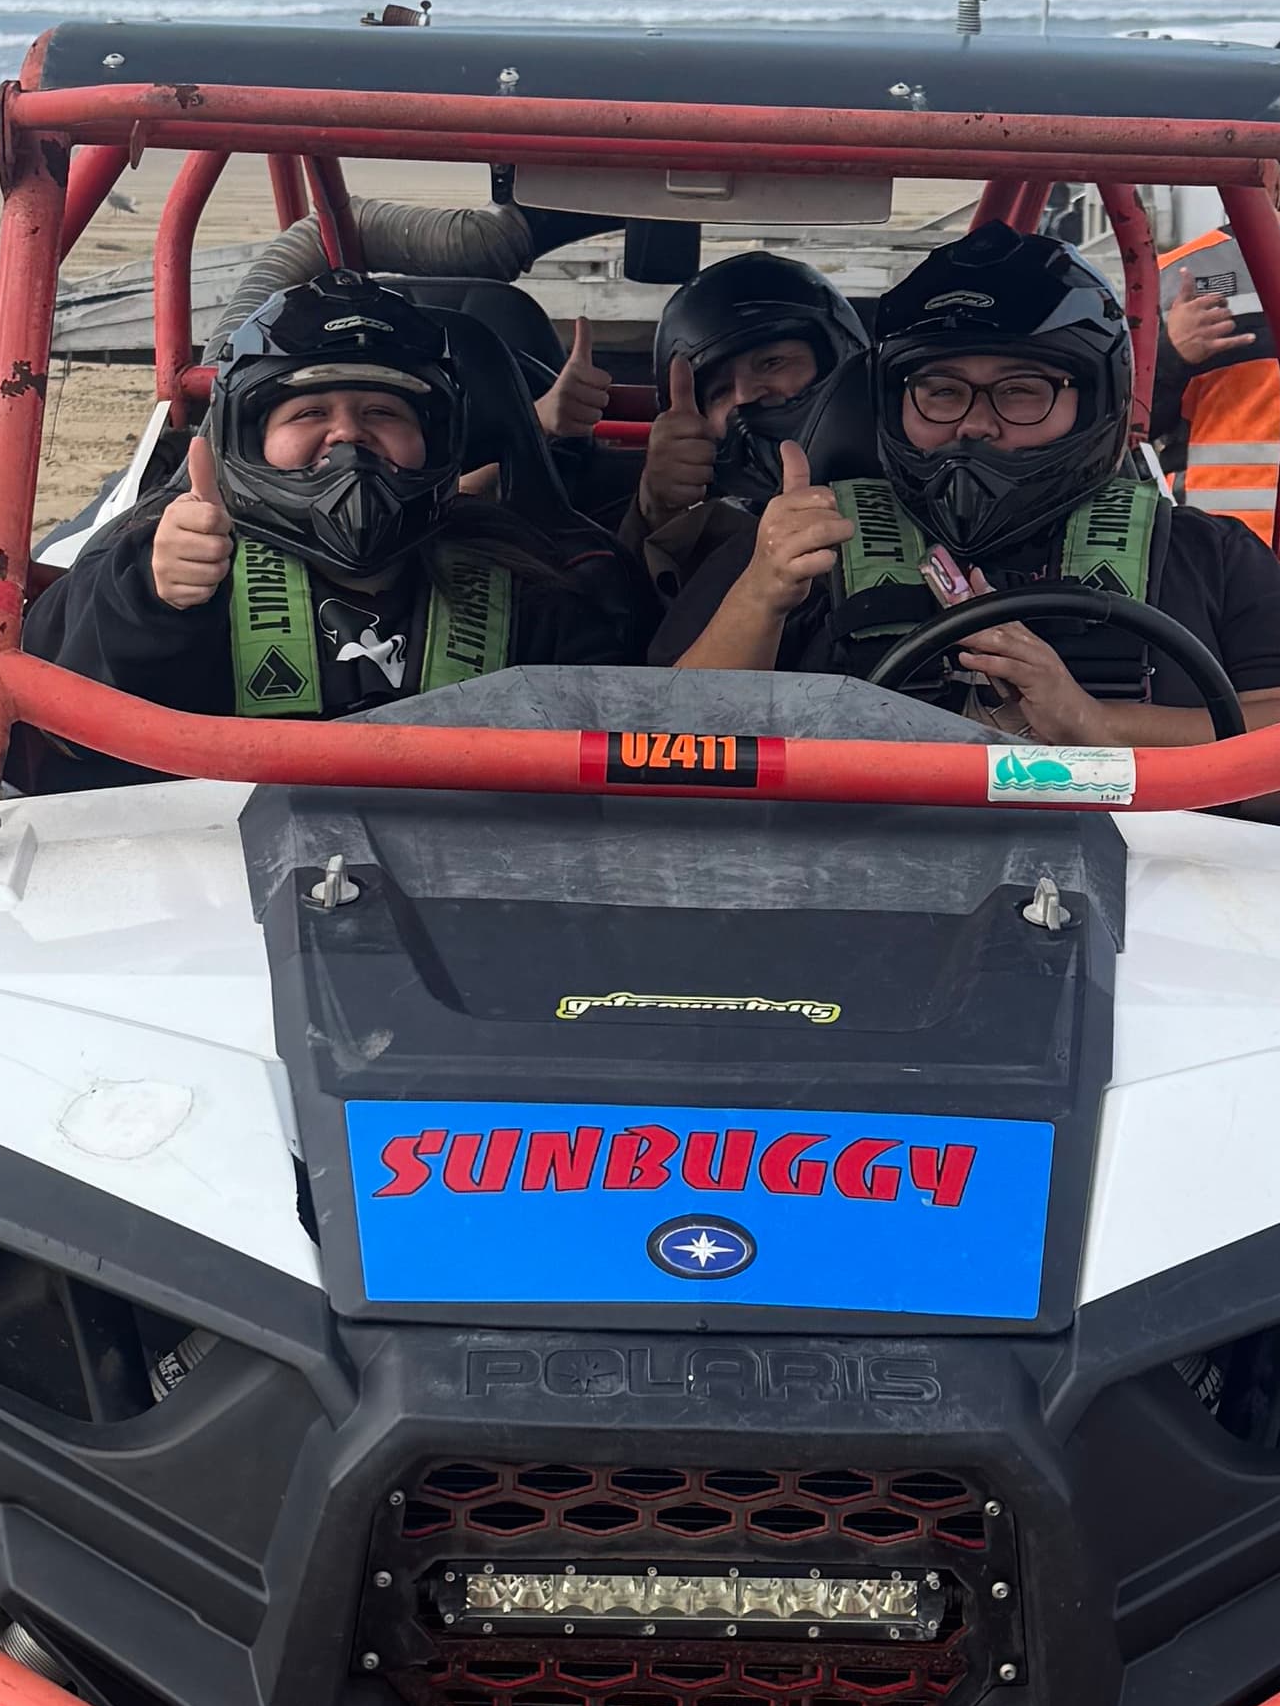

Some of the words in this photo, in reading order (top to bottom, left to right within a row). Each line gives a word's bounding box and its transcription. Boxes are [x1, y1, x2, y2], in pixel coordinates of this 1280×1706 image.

[1086, 485, 1137, 552] SSAULT
[244, 541, 291, 635] SSAULT
[621, 732, 736, 771] UZ411
[372, 1124, 977, 1208] SUNBUGGY
[466, 1347, 942, 1405] POLARIS
